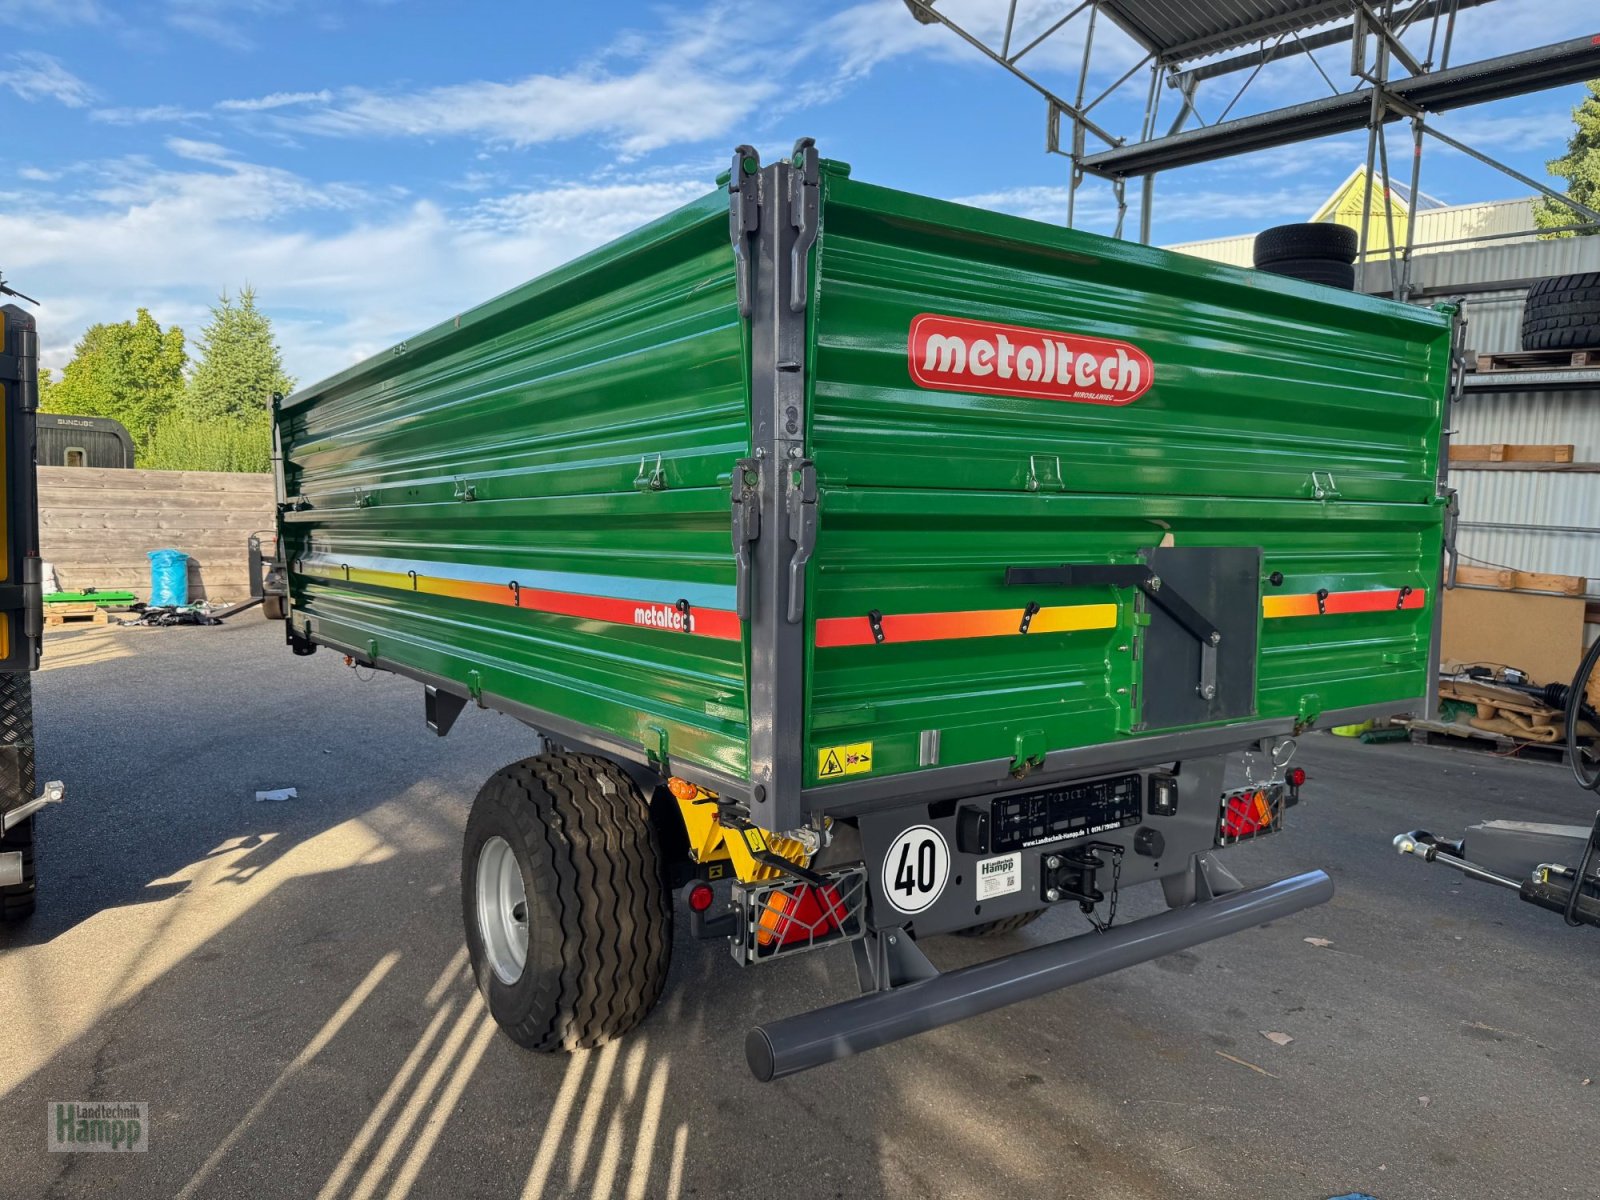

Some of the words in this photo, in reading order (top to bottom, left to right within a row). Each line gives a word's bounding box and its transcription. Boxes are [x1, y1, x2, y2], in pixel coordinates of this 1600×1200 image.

[922, 332, 1141, 392] metaltech
[894, 839, 936, 896] 40
[982, 861, 1014, 875] Hampp
